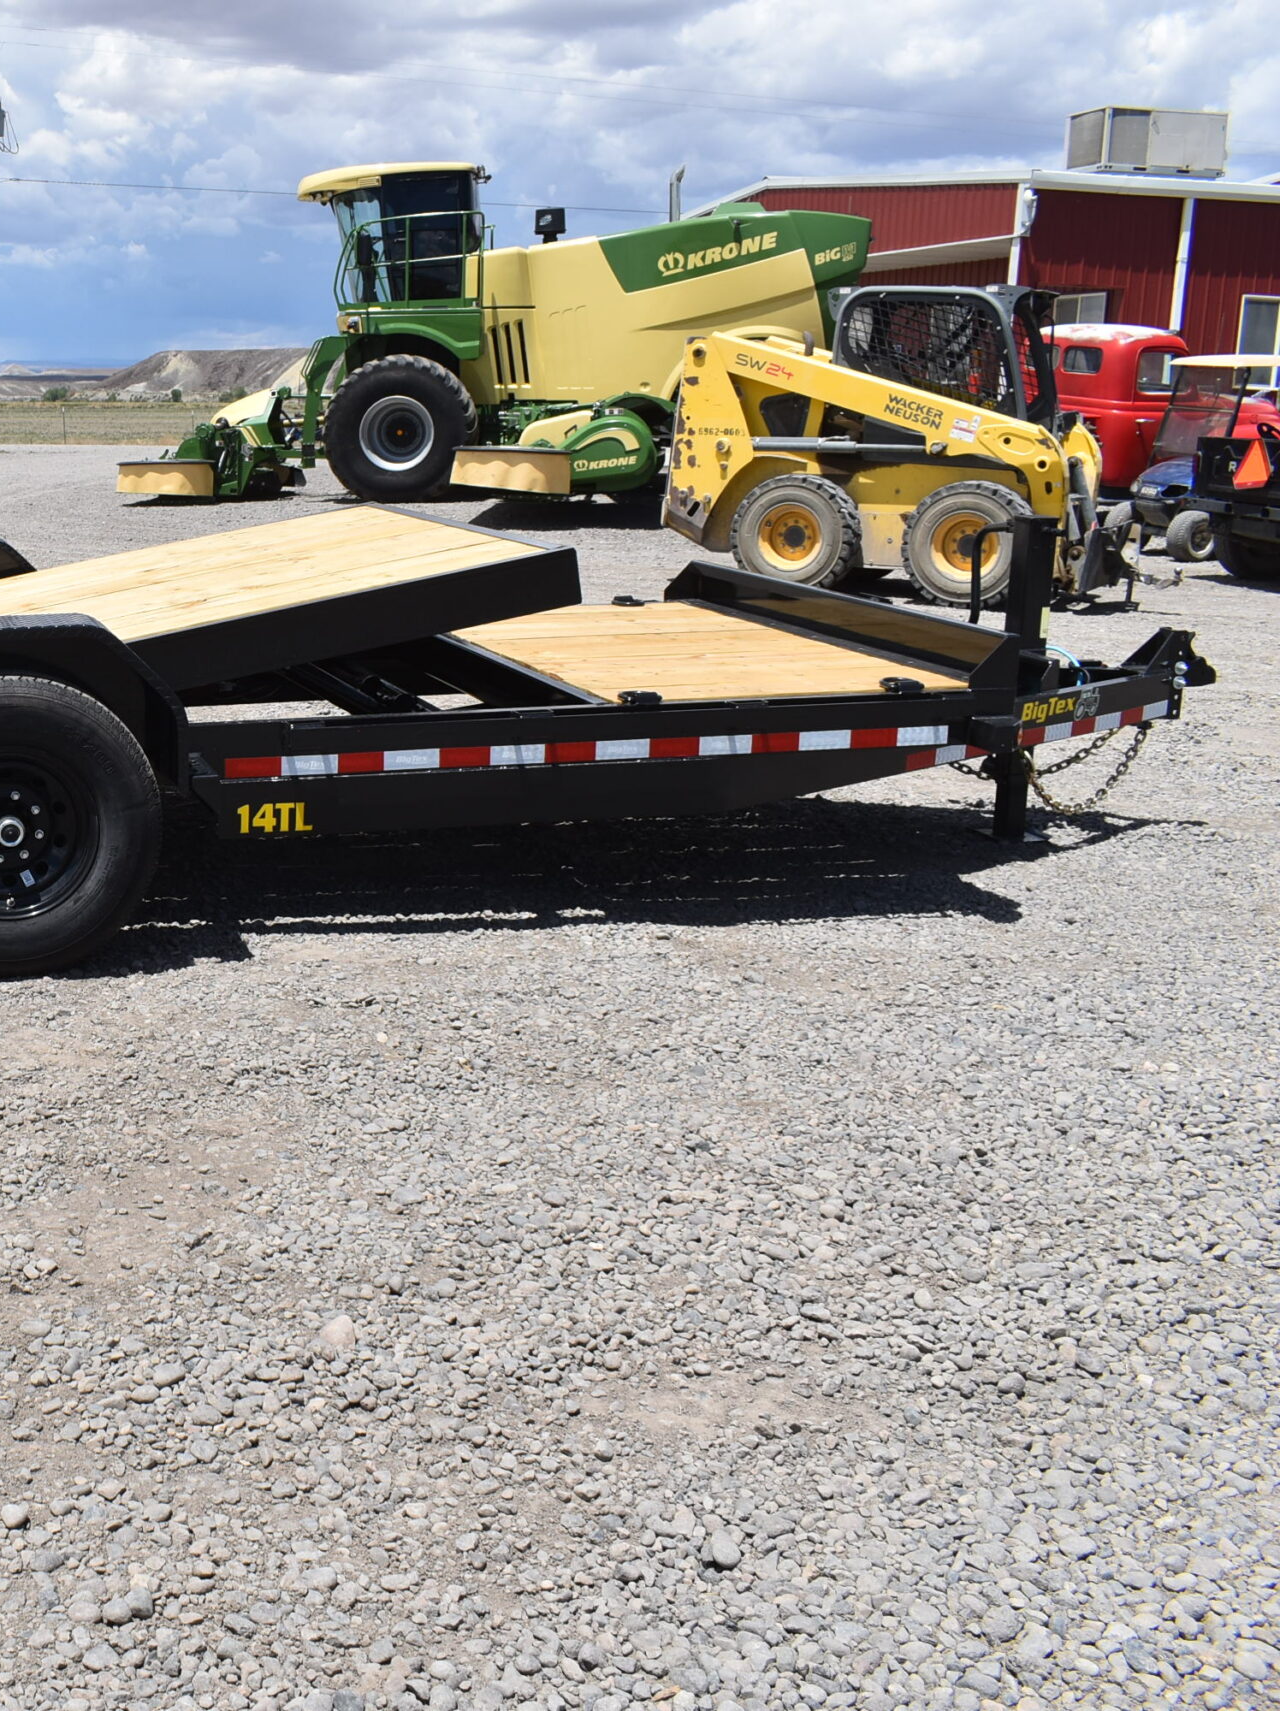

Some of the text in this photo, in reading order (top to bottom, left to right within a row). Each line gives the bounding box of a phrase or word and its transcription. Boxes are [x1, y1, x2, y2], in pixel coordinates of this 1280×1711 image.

[686, 231, 778, 270] KRONE
[735, 353, 794, 380] SW24
[884, 403, 941, 430] NEUSON
[888, 393, 944, 420] WACKER
[588, 455, 638, 470] KRONE
[1022, 696, 1076, 723] BigTex
[237, 802, 313, 834] 14TL
